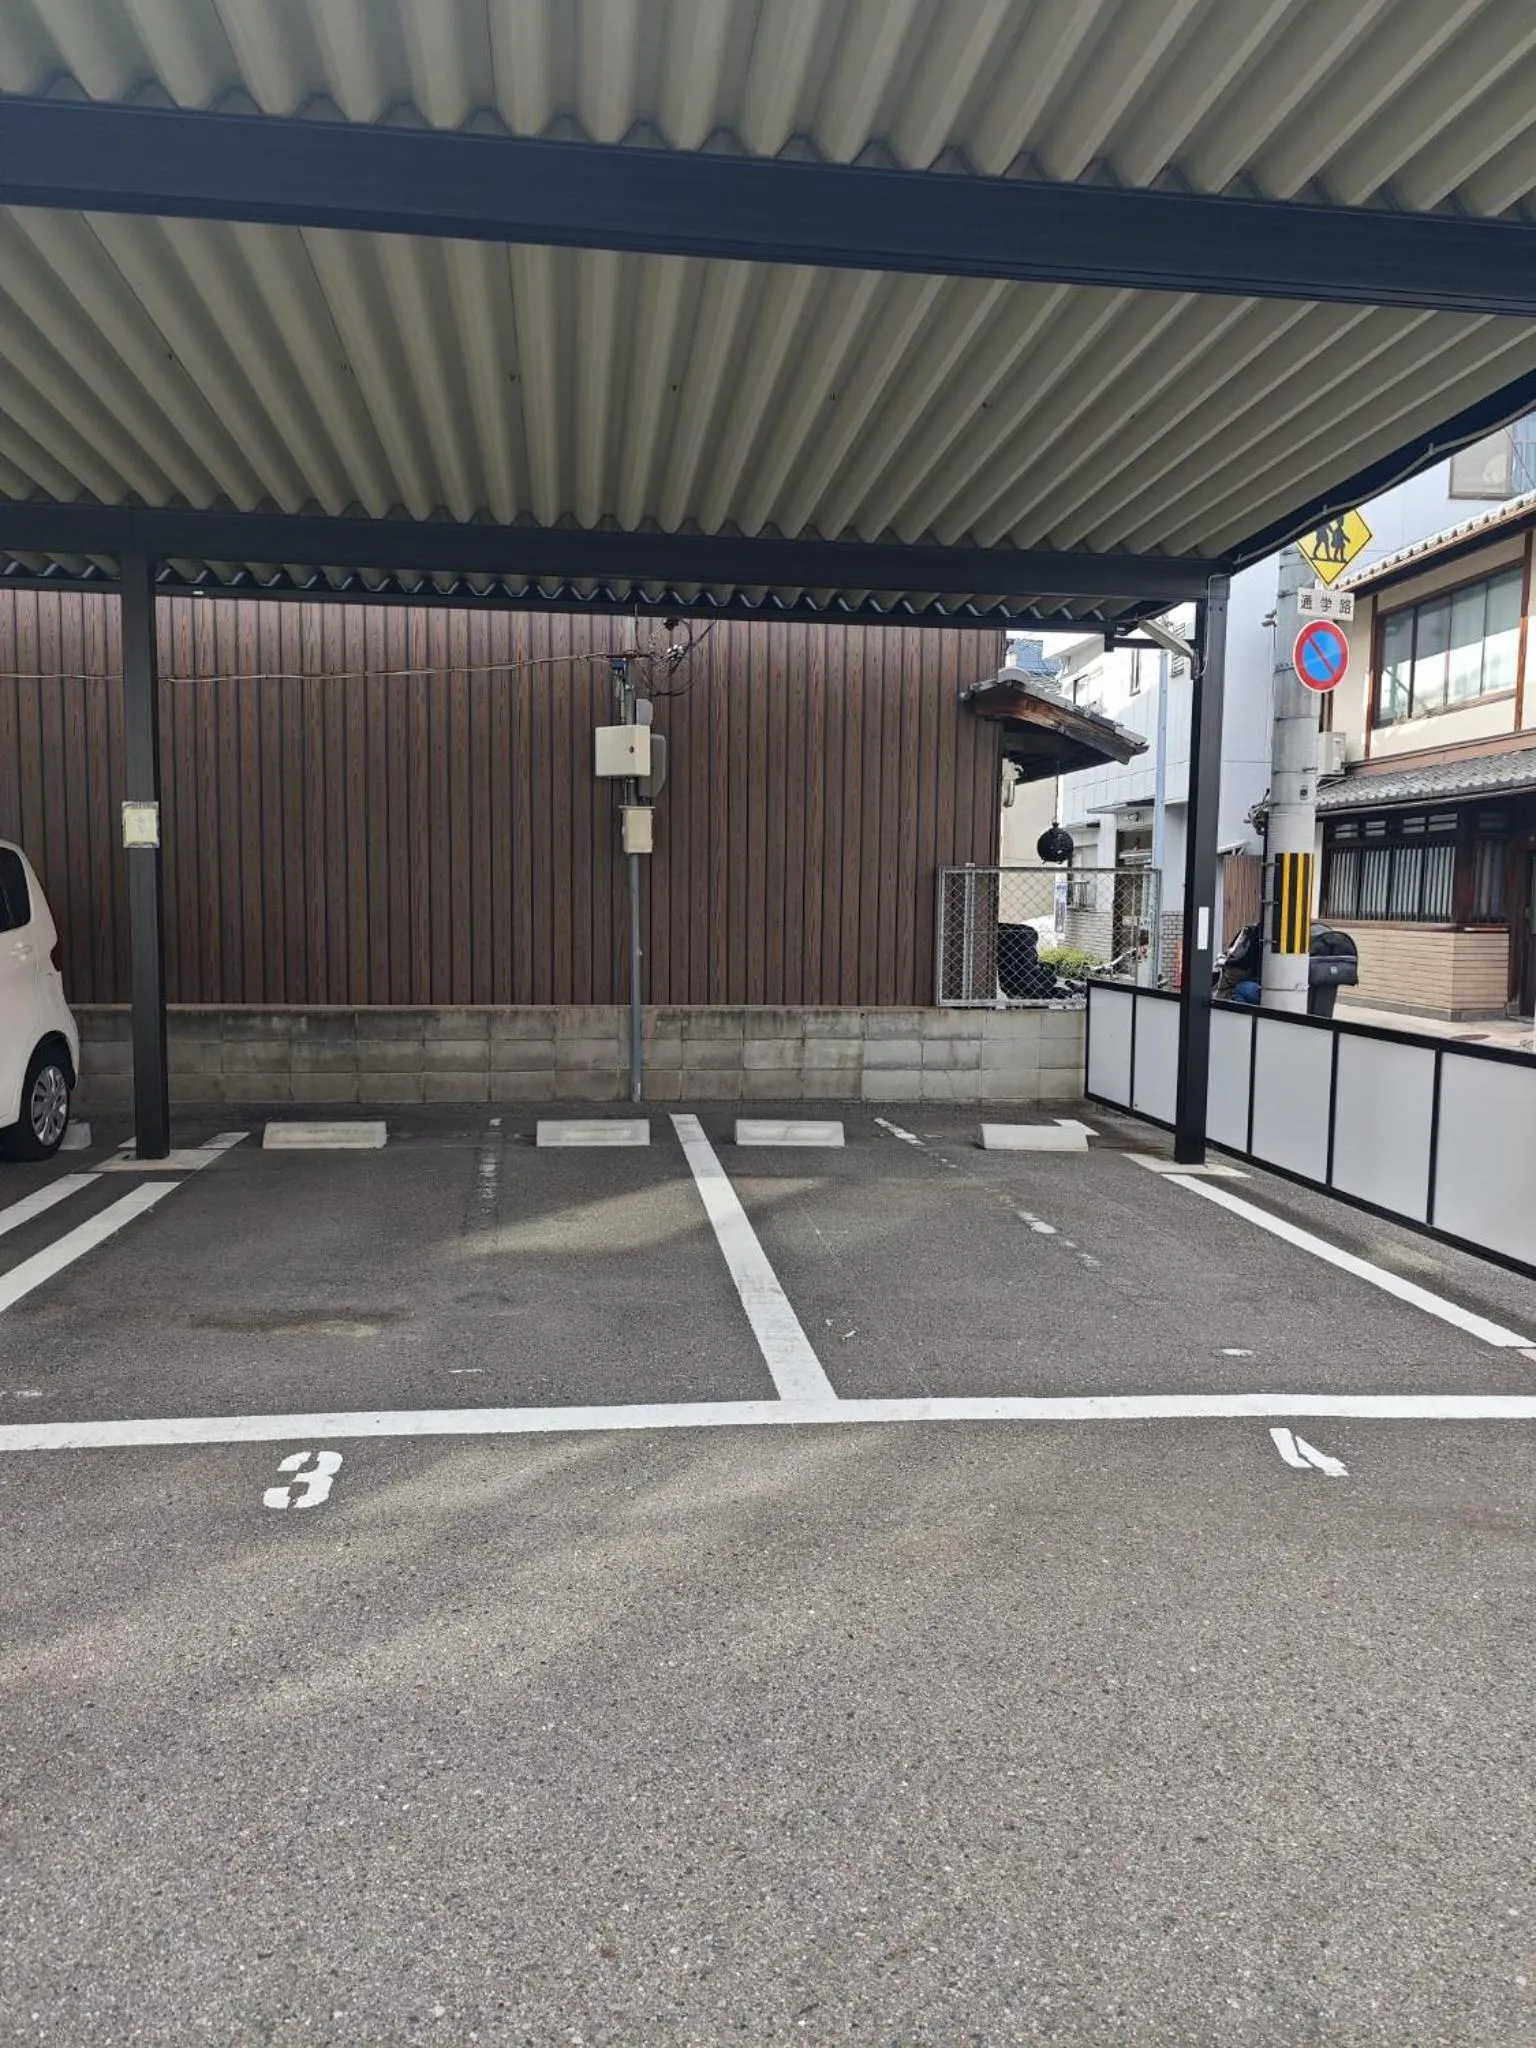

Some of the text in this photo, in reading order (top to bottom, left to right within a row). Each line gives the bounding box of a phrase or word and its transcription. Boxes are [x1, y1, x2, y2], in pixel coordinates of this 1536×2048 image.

[1300, 594, 1353, 615] 通学路
[1268, 1427, 1350, 1477] 4
[263, 1450, 343, 1509] 3
